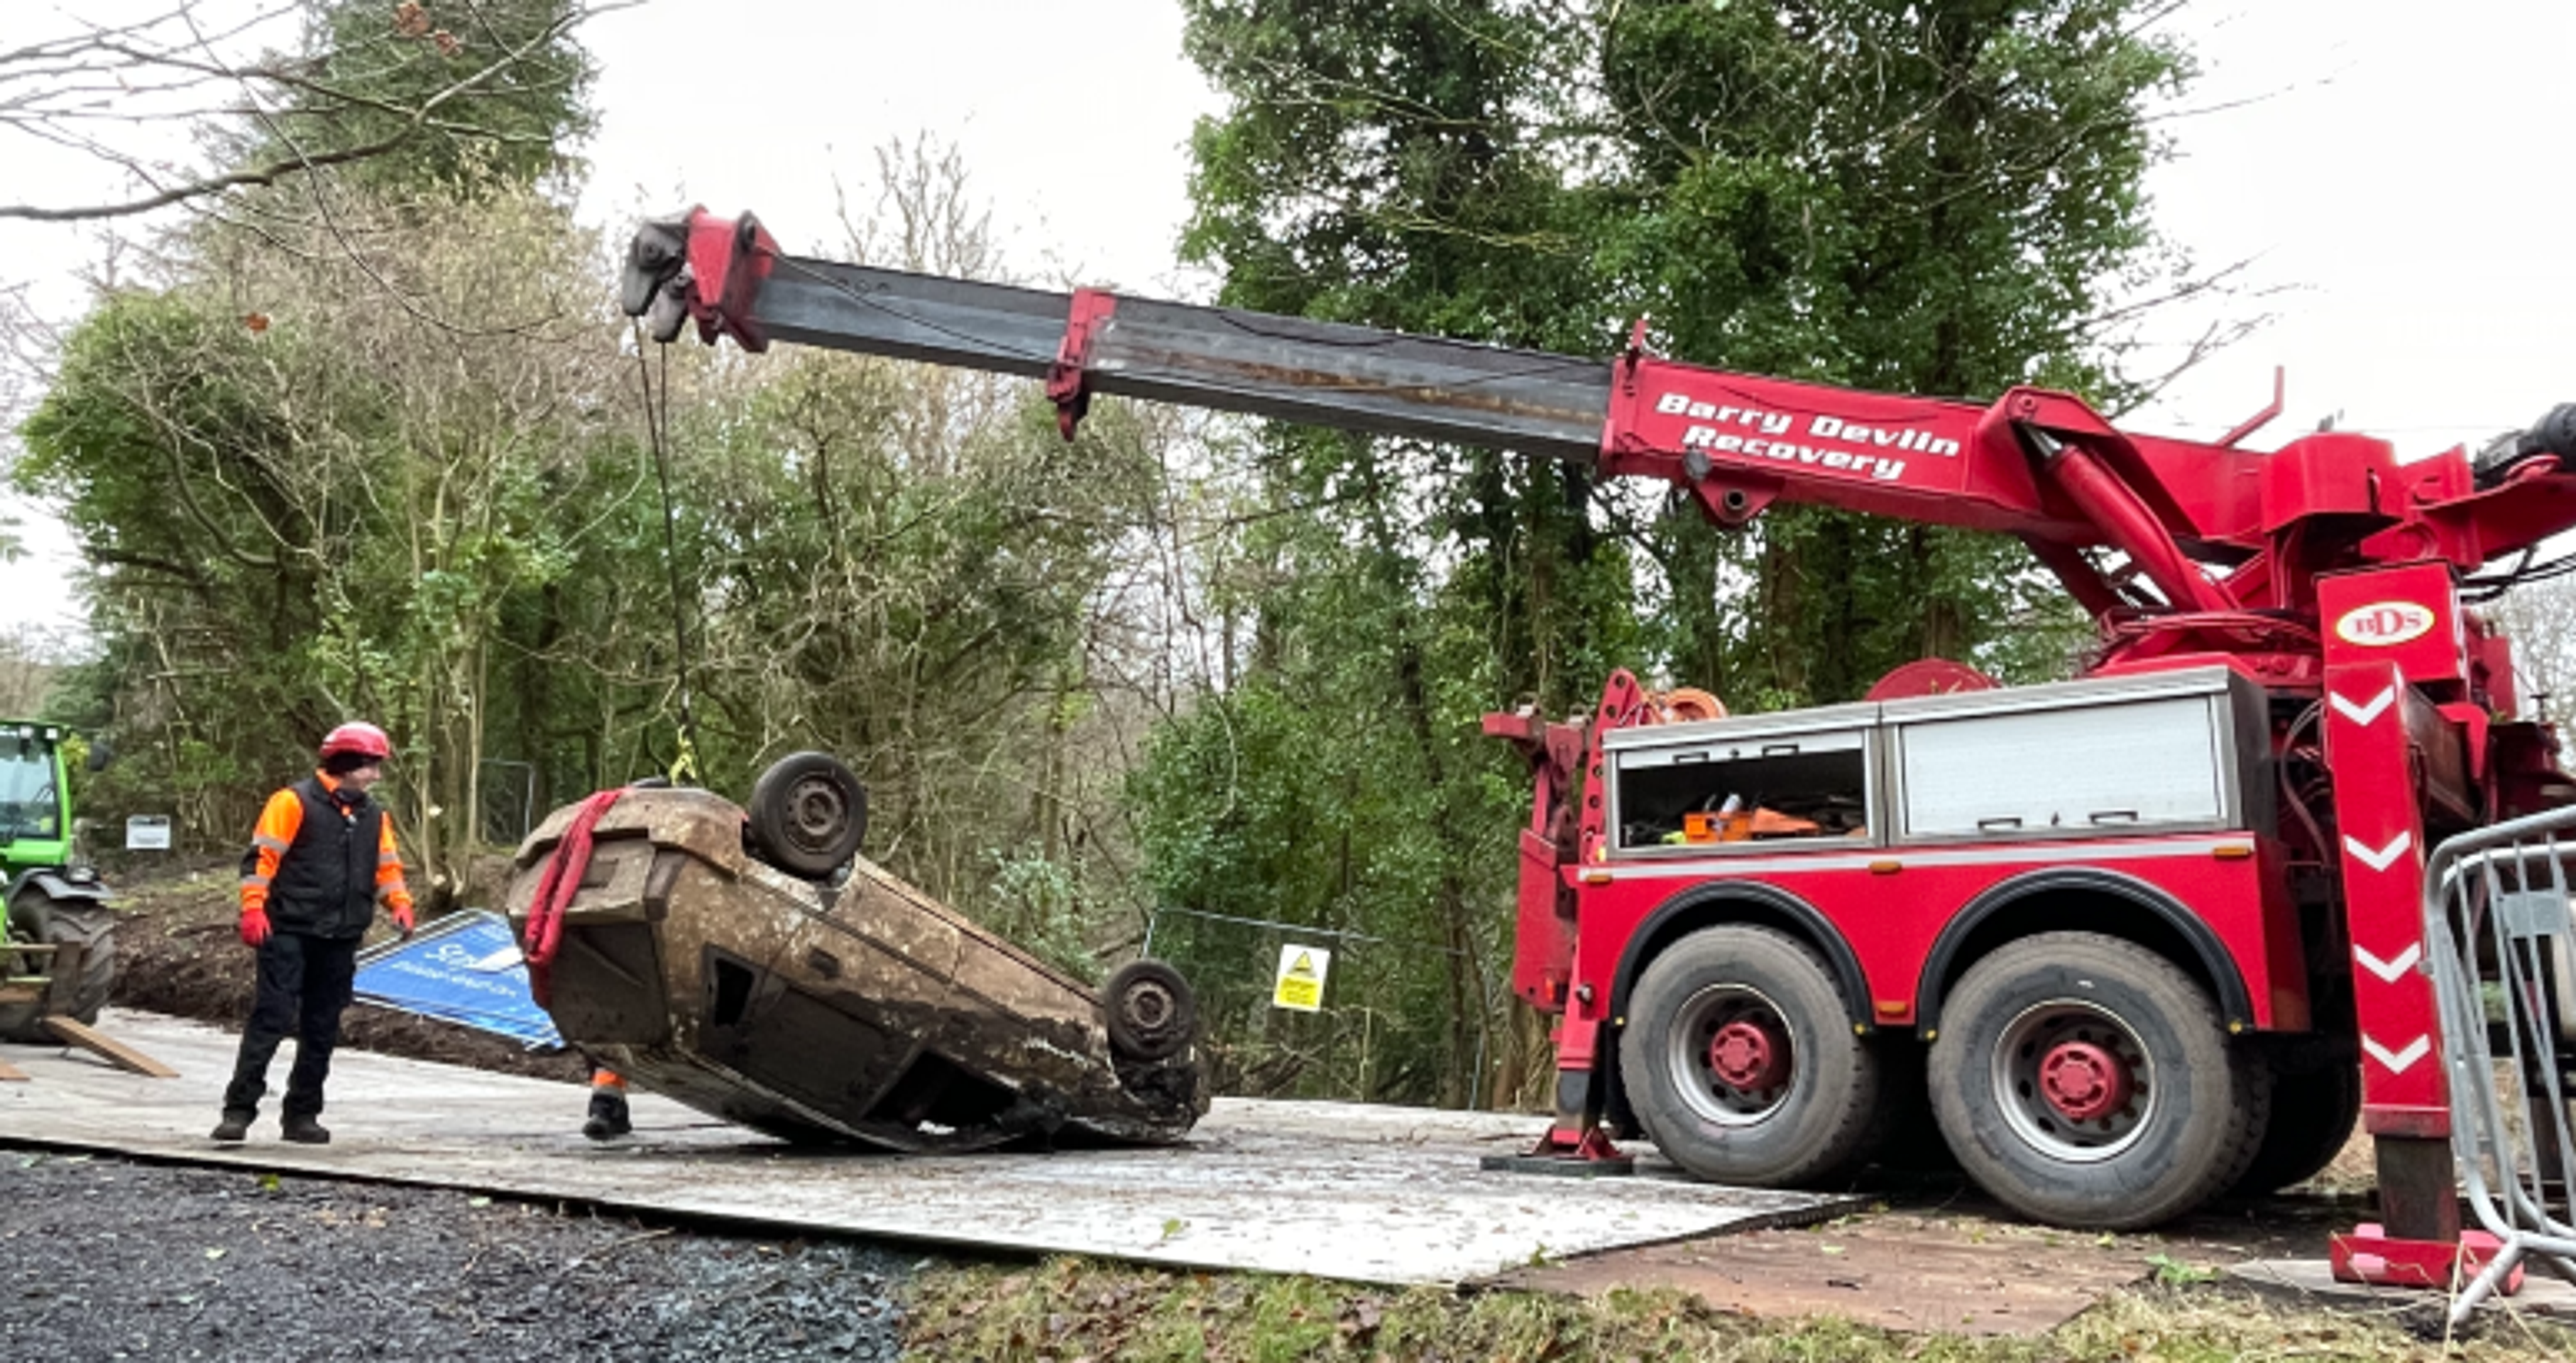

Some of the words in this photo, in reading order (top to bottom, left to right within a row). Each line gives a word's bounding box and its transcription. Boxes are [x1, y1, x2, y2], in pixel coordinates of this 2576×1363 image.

[1655, 393, 1792, 435] Barry
[1809, 415, 1960, 456] Devlin
[1682, 426, 1906, 481] Recovery
[2355, 609, 2421, 636] BDS
